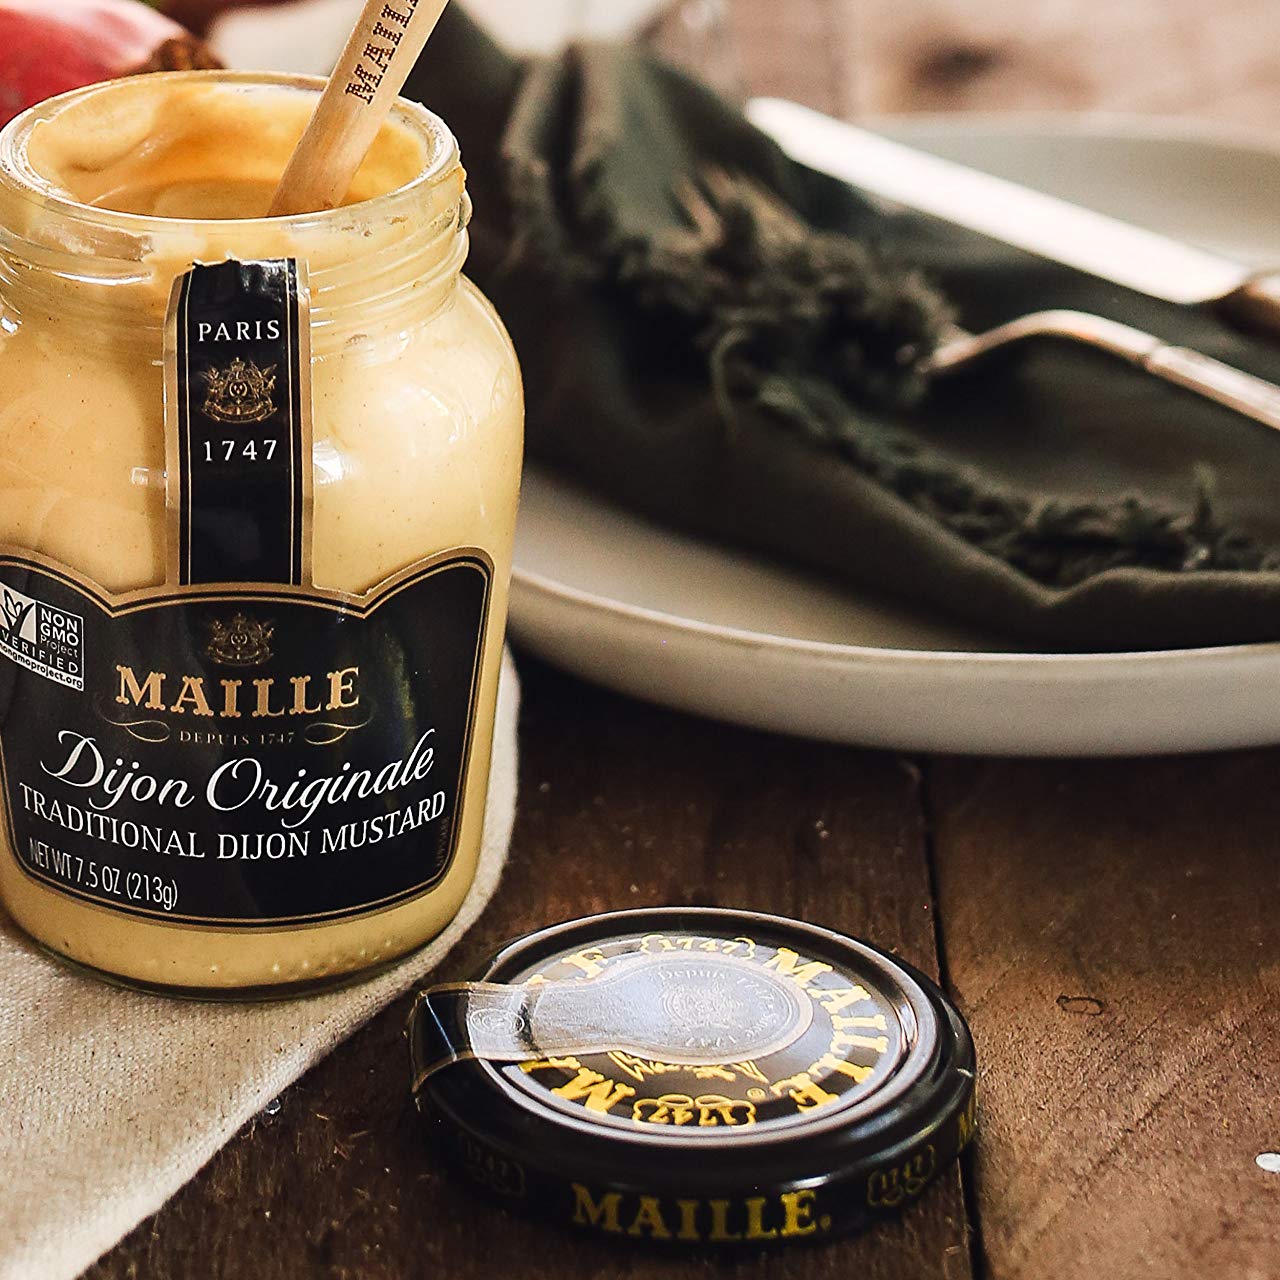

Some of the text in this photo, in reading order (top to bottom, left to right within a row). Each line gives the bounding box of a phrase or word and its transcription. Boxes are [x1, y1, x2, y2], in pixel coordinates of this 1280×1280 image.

[198, 320, 281, 342] PARIS
[204, 439, 278, 462] 1747
[41, 607, 78, 634] NON
[40, 622, 79, 647] GMO
[40, 634, 79, 659] Project
[1, 629, 79, 674] VERIFIED
[0, 642, 84, 689] nongmoproject.org
[115, 664, 362, 718] MAILLE
[180, 730, 295, 746] DEPUIS 1747
[40, 728, 437, 829] Dijon Originale
[20, 781, 205, 859] TRADITIONAL
[216, 830, 312, 861] DIJON
[320, 790, 447, 855] MUSTARD
[29, 836, 179, 911] NET WT 7.5 OZ (213g)
[657, 938, 742, 955] 1747
[647, 1104, 739, 1127] 1747
